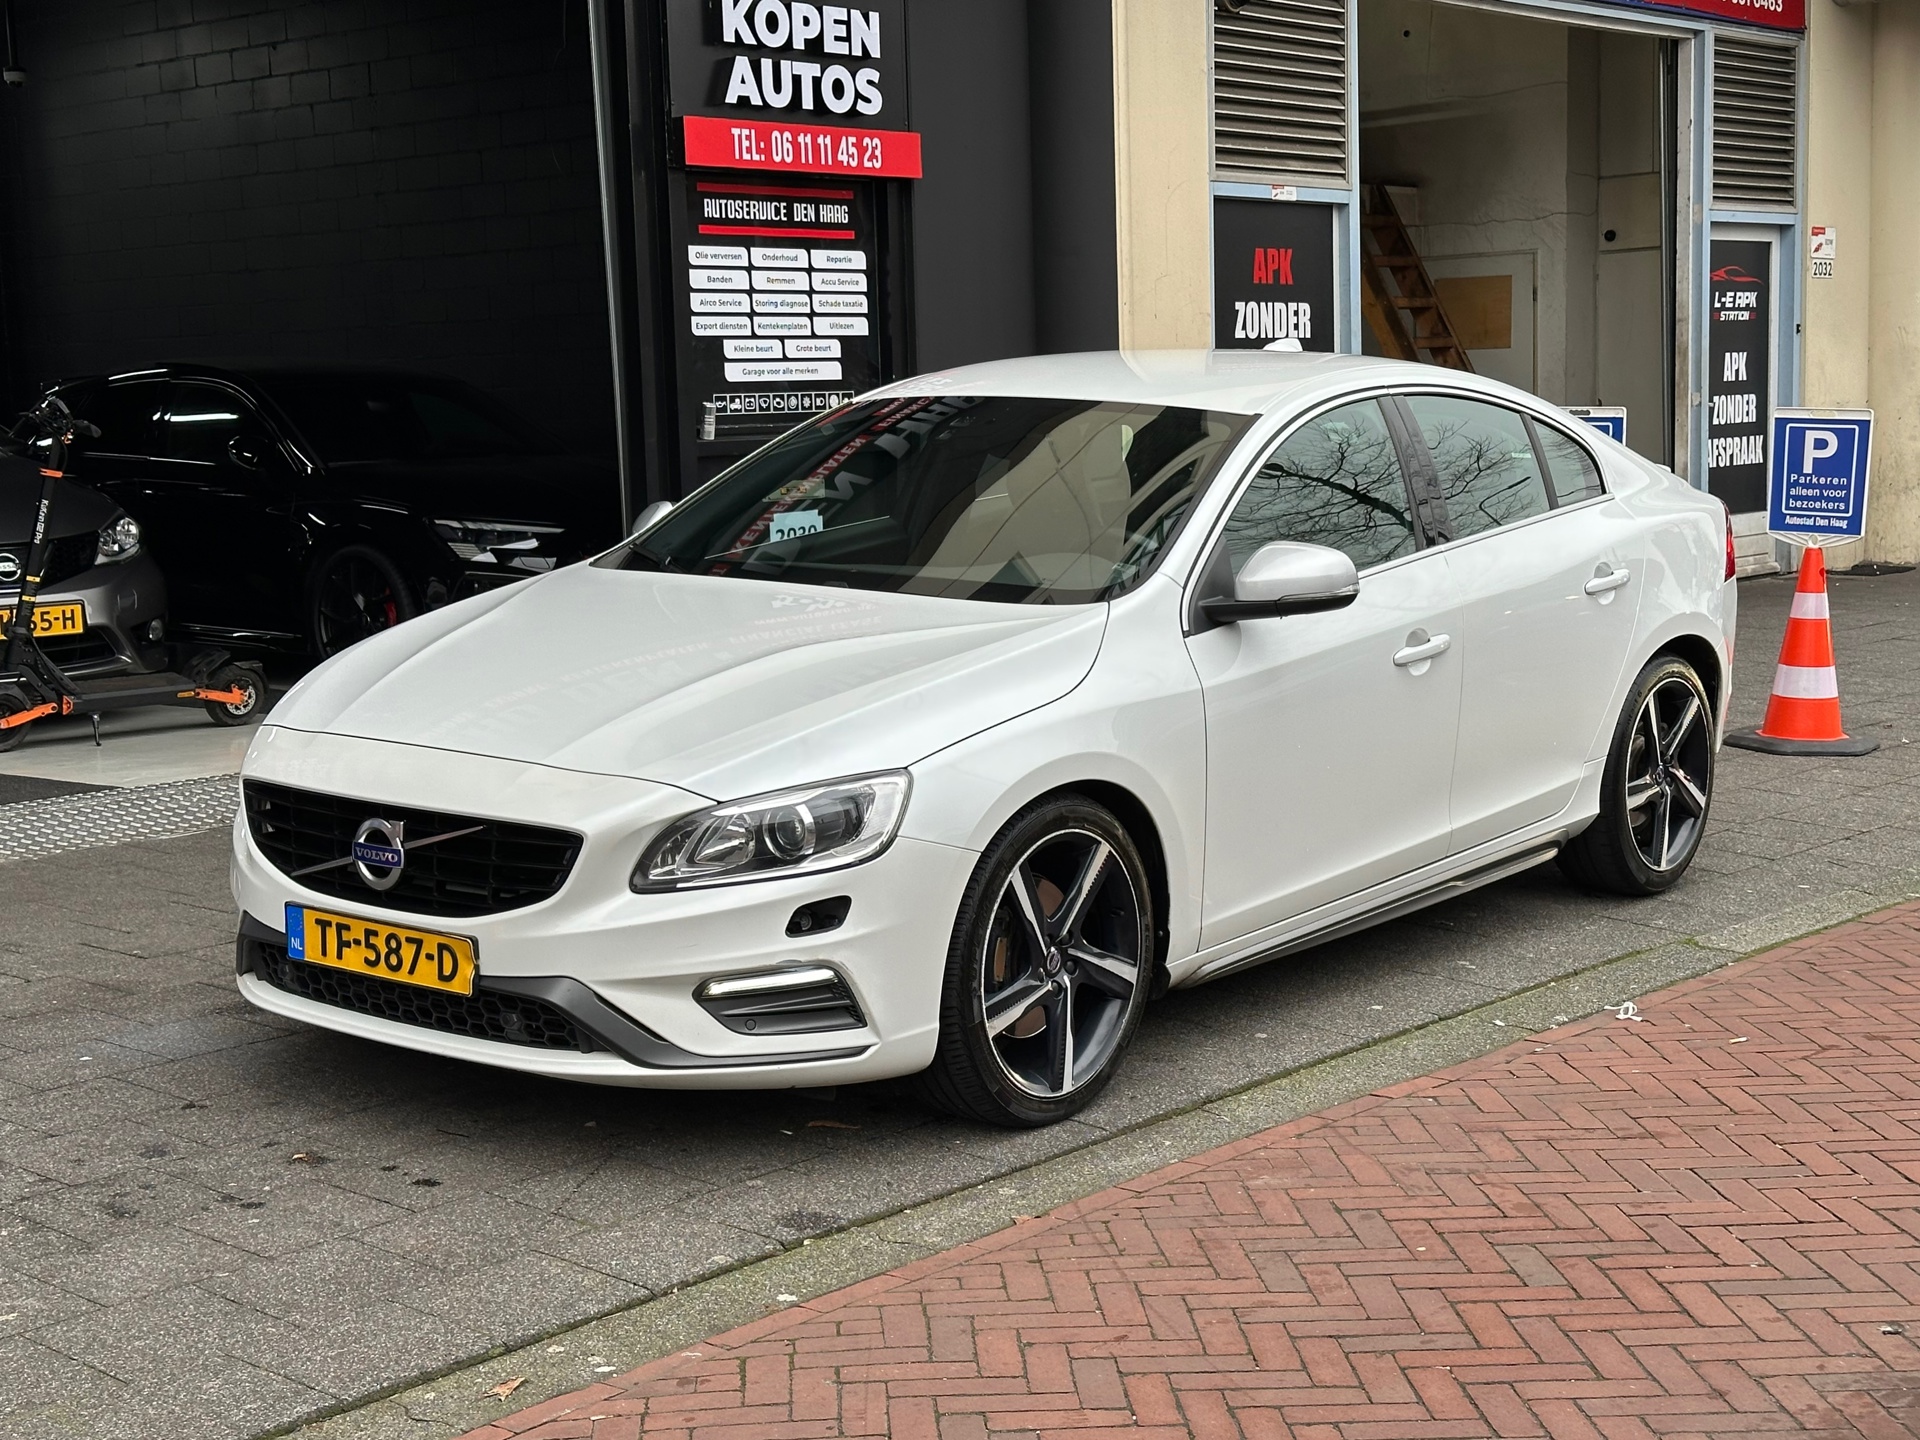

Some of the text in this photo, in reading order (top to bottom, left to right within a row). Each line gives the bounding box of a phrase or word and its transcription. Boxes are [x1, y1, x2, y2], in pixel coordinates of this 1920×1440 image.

[721, 0, 881, 58] KOPEN
[725, 55, 883, 116] AUTOS
[731, 127, 883, 170] TEL: 06 11 11 45 23
[793, 202, 815, 223] DEN
[819, 204, 849, 224] HAAG
[695, 251, 743, 261] Olie verversen
[762, 253, 799, 262] Onderhoud
[826, 255, 853, 264] Repartie
[1253, 247, 1294, 285] APK
[1813, 261, 1833, 277] 2032
[707, 275, 733, 284] Banden
[766, 276, 796, 285] Remmen
[821, 277, 860, 286] Accu Service
[699, 298, 742, 307] Airco Service
[755, 299, 809, 309] Storing diagnose
[818, 299, 863, 308] Schade taxatie
[1714, 291, 1758, 308] L-E APK
[1234, 301, 1312, 339] ZONDER
[1720, 310, 1750, 321] STATION
[695, 321, 748, 331] Export diensten
[757, 322, 808, 331] Kentekenplaten
[829, 322, 855, 330] Uitlezen
[733, 344, 774, 353] Kleine beurt
[814, 344, 832, 352] beurt
[742, 367, 765, 377] Garage
[782, 366, 793, 375] alle
[795, 366, 819, 375] merken
[1723, 352, 1748, 382] APK
[1712, 393, 1757, 425] ZONDER
[1708, 434, 1764, 468] AFSPRAAK
[1803, 430, 1838, 474] P
[1790, 473, 1847, 485] Parkeren
[1789, 486, 1847, 498] alleen voor
[1789, 498, 1845, 510] bezoekers
[1785, 515, 1848, 529] Autostad Den Haag
[355, 847, 398, 862] VOLVO
[291, 937, 303, 951] NL
[314, 917, 459, 983] TF-587-D
